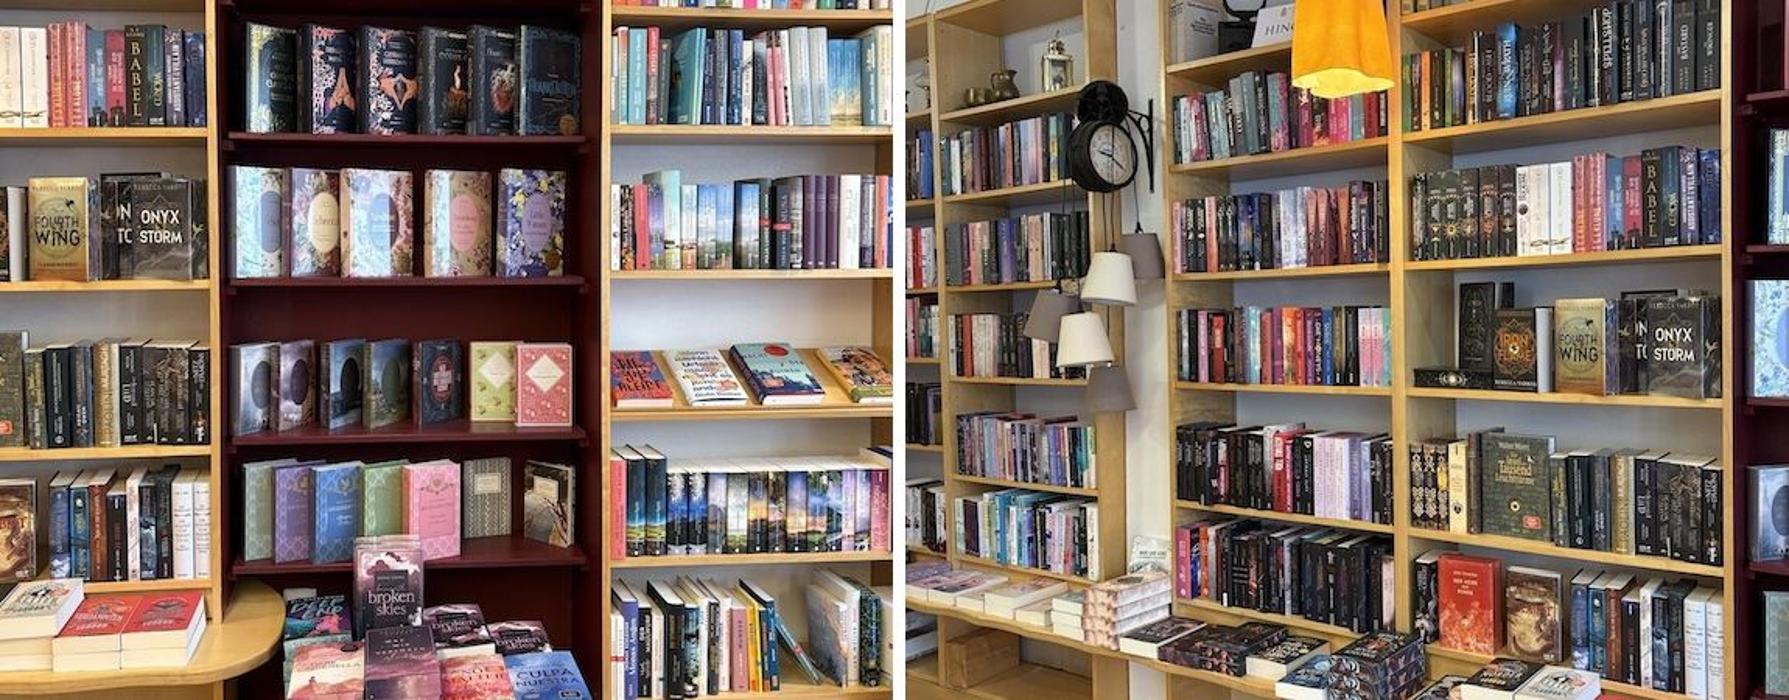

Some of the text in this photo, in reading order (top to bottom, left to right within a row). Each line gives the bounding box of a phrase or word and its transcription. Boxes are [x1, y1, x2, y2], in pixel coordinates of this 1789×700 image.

[1602, 8, 1613, 69] SPELLSHOP
[130, 42, 143, 117] BABEL
[153, 72, 164, 107] WICKED
[1646, 165, 1658, 238] BABEL
[141, 209, 180, 225] ONYX
[1668, 192, 1679, 227] WICKED
[34, 215, 80, 228] FOURTH
[35, 231, 81, 246] WING
[140, 231, 183, 244] STORM
[1500, 332, 1529, 346] IRON
[1560, 332, 1598, 345] FOURTH
[1654, 327, 1693, 343] ONYX
[1559, 346, 1599, 363] WING
[1654, 346, 1695, 362] STORM
[368, 590, 415, 605] broken
[376, 602, 408, 617] skies
[432, 619, 478, 631] broken
[495, 636, 542, 647] broken
[517, 667, 574, 679] CULPA
[516, 676, 581, 687] NUESTRA
